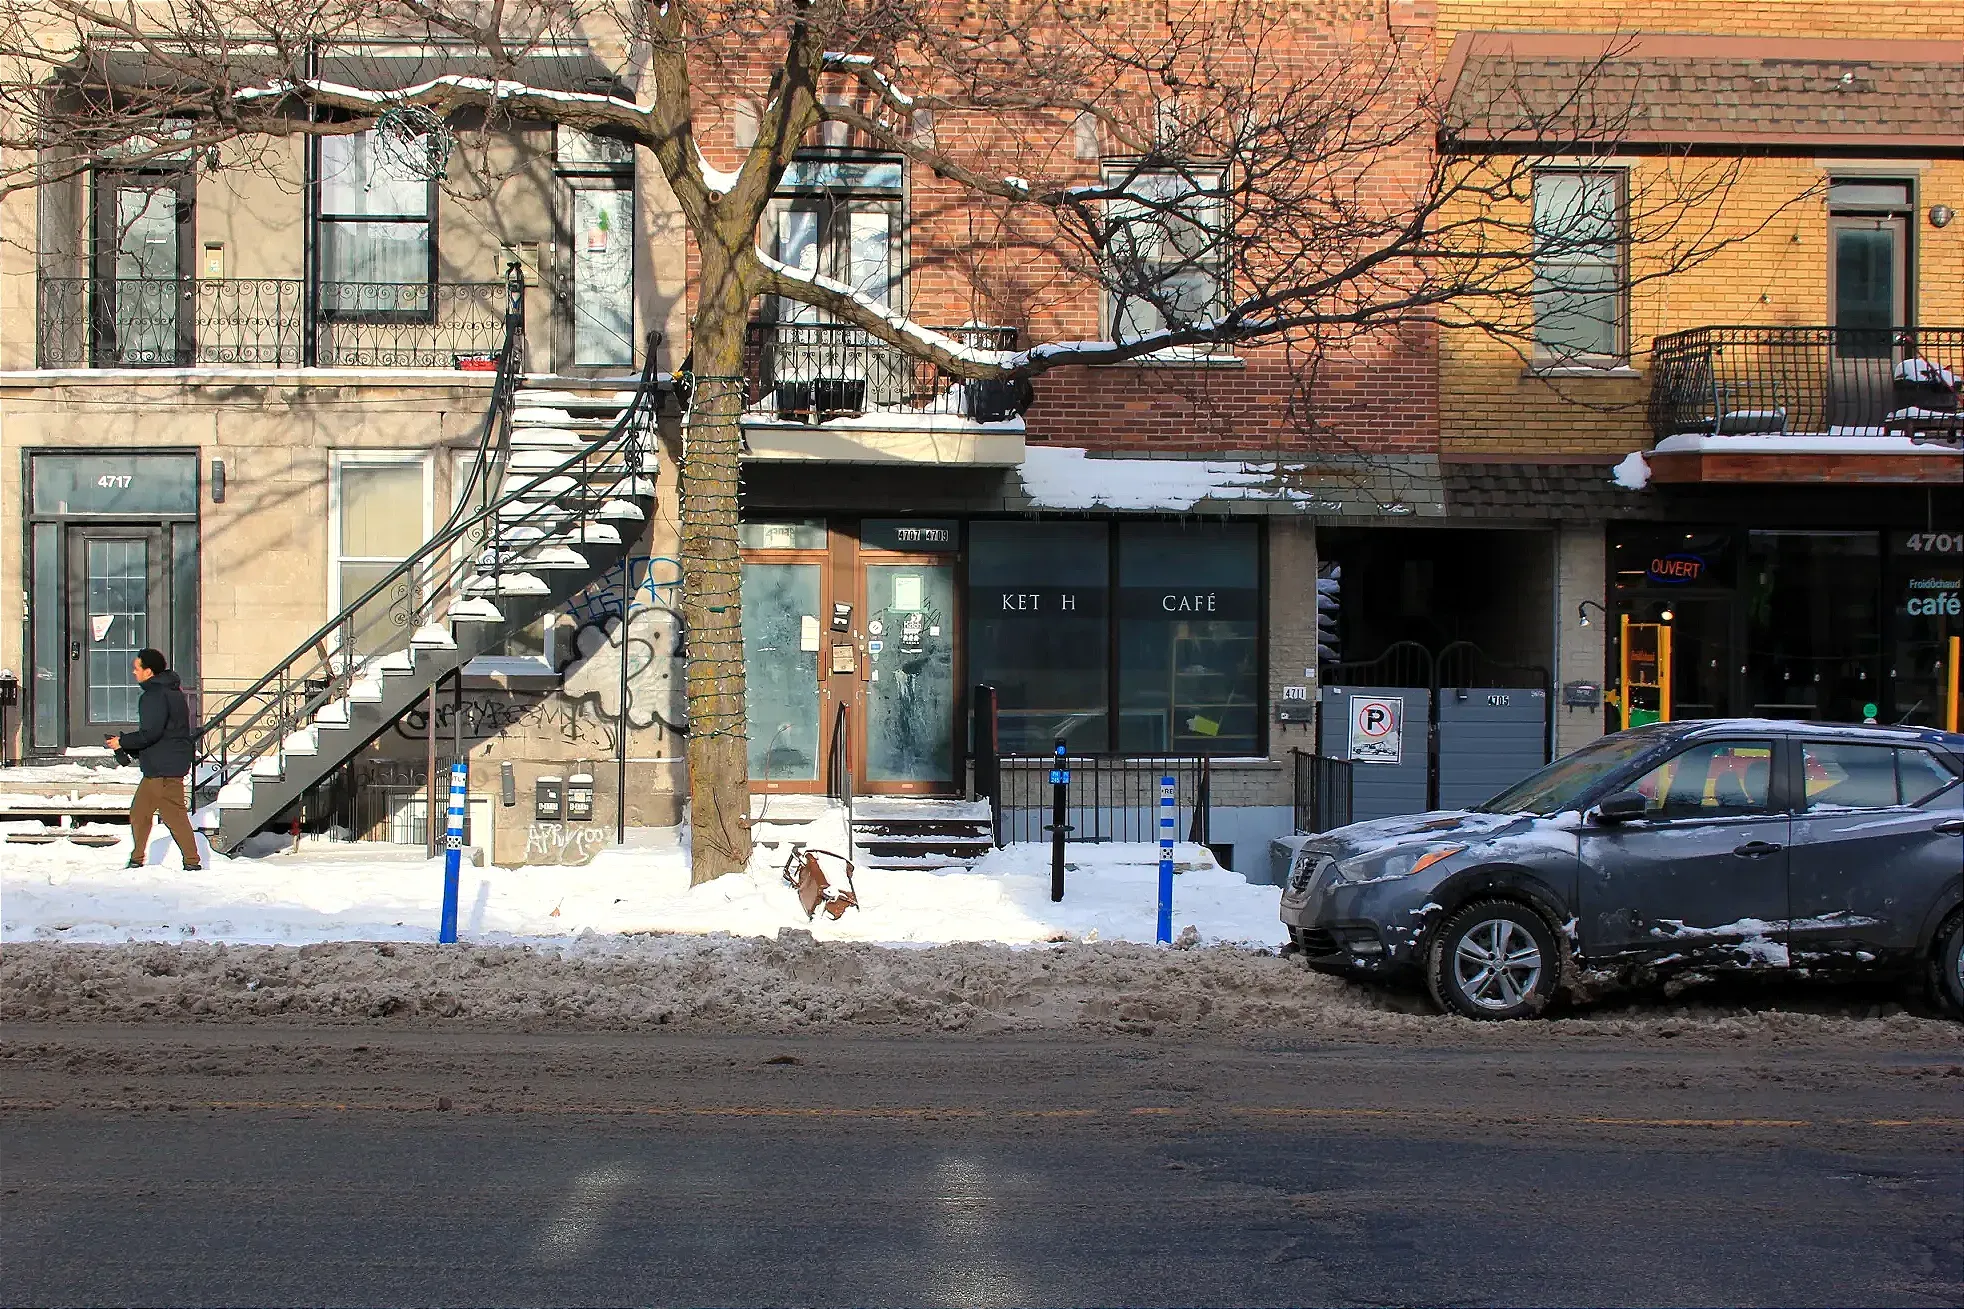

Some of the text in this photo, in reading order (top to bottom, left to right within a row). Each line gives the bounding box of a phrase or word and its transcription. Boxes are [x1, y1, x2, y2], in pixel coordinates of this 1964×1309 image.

[98, 475, 132, 488] 4717
[898, 530, 948, 542] 4707 4709
[1906, 533, 1964, 552] 4701
[1651, 558, 1701, 579] OUVERT
[1162, 592, 1217, 612] CAFÉ
[1907, 592, 1961, 616] café
[1284, 688, 1306, 699] 4711
[1487, 695, 1509, 706] 4705
[1366, 709, 1385, 731] P
